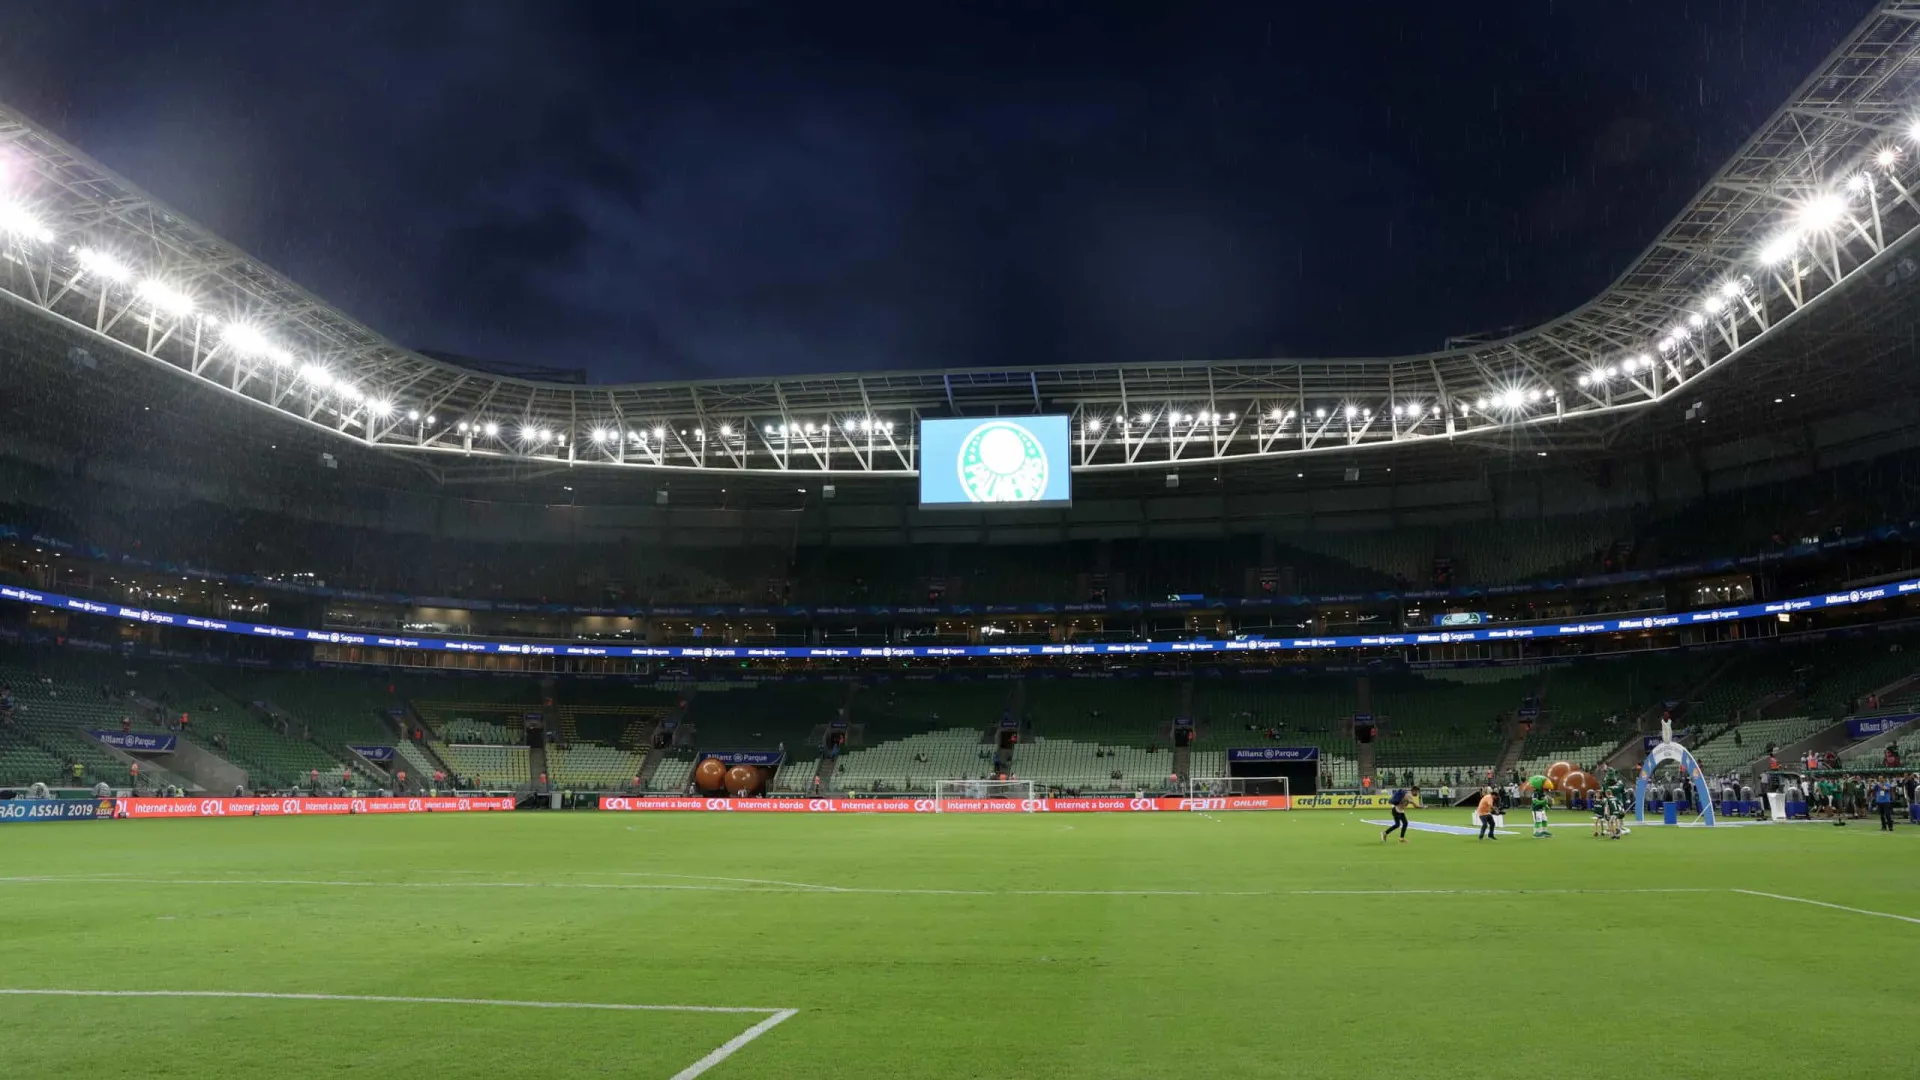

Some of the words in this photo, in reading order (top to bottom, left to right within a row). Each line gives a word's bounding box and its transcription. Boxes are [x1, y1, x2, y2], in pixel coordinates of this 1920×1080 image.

[1826, 594, 1849, 604] Allianz
[1859, 589, 1884, 600] Seguros
[120, 607, 140, 619] Allianz
[150, 612, 173, 624] Seguros
[1618, 620, 1642, 629] Allianz
[1653, 617, 1679, 627] Seguros
[307, 631, 330, 641] Allianz
[340, 633, 364, 644] Seguros
[1417, 634, 1440, 642] Allianz
[1450, 632, 1475, 642] Seguros
[498, 644, 520, 653] Allianz
[530, 645, 554, 655] Seguros
[1042, 645, 1063, 653] Allianz
[1072, 645, 1094, 654] Seguros
[1226, 641, 1248, 649] Allianz
[1257, 640, 1280, 650] Seguros
[682, 648, 704, 656] Allianz
[712, 648, 735, 657] Seguros
[861, 648, 882, 656] Allianz
[891, 647, 914, 657] Seguros
[100, 735, 124, 744] Allianz
[135, 737, 156, 747] Parque
[1275, 750, 1299, 758] Parque
[229, 802, 255, 812] Internet
[261, 802, 279, 811] bordo
[282, 800, 301, 814] GOL
[351, 800, 367, 813] GOL
[409, 800, 422, 811] GOL
[458, 799, 470, 810] GOL
[502, 799, 514, 810] GOL
[605, 798, 632, 810] GOL
[677, 800, 701, 808] bordo
[706, 798, 733, 810] GOL
[738, 801, 771, 809] Internet
[780, 801, 804, 809] bordo
[809, 799, 836, 811] GOL
[884, 801, 909, 809] bordo
[1021, 799, 1050, 811] GOL
[1055, 801, 1089, 809] Internet
[1099, 801, 1125, 809] bordo
[1130, 798, 1159, 811] GOL
[1298, 795, 1332, 808] crefisa
[1338, 795, 1372, 808] crefisa
[29, 804, 64, 817] ASSAÍ
[68, 804, 93, 816] 2019
[135, 803, 167, 813] Internet
[175, 803, 196, 812] bordo
[201, 800, 225, 815] GOL
